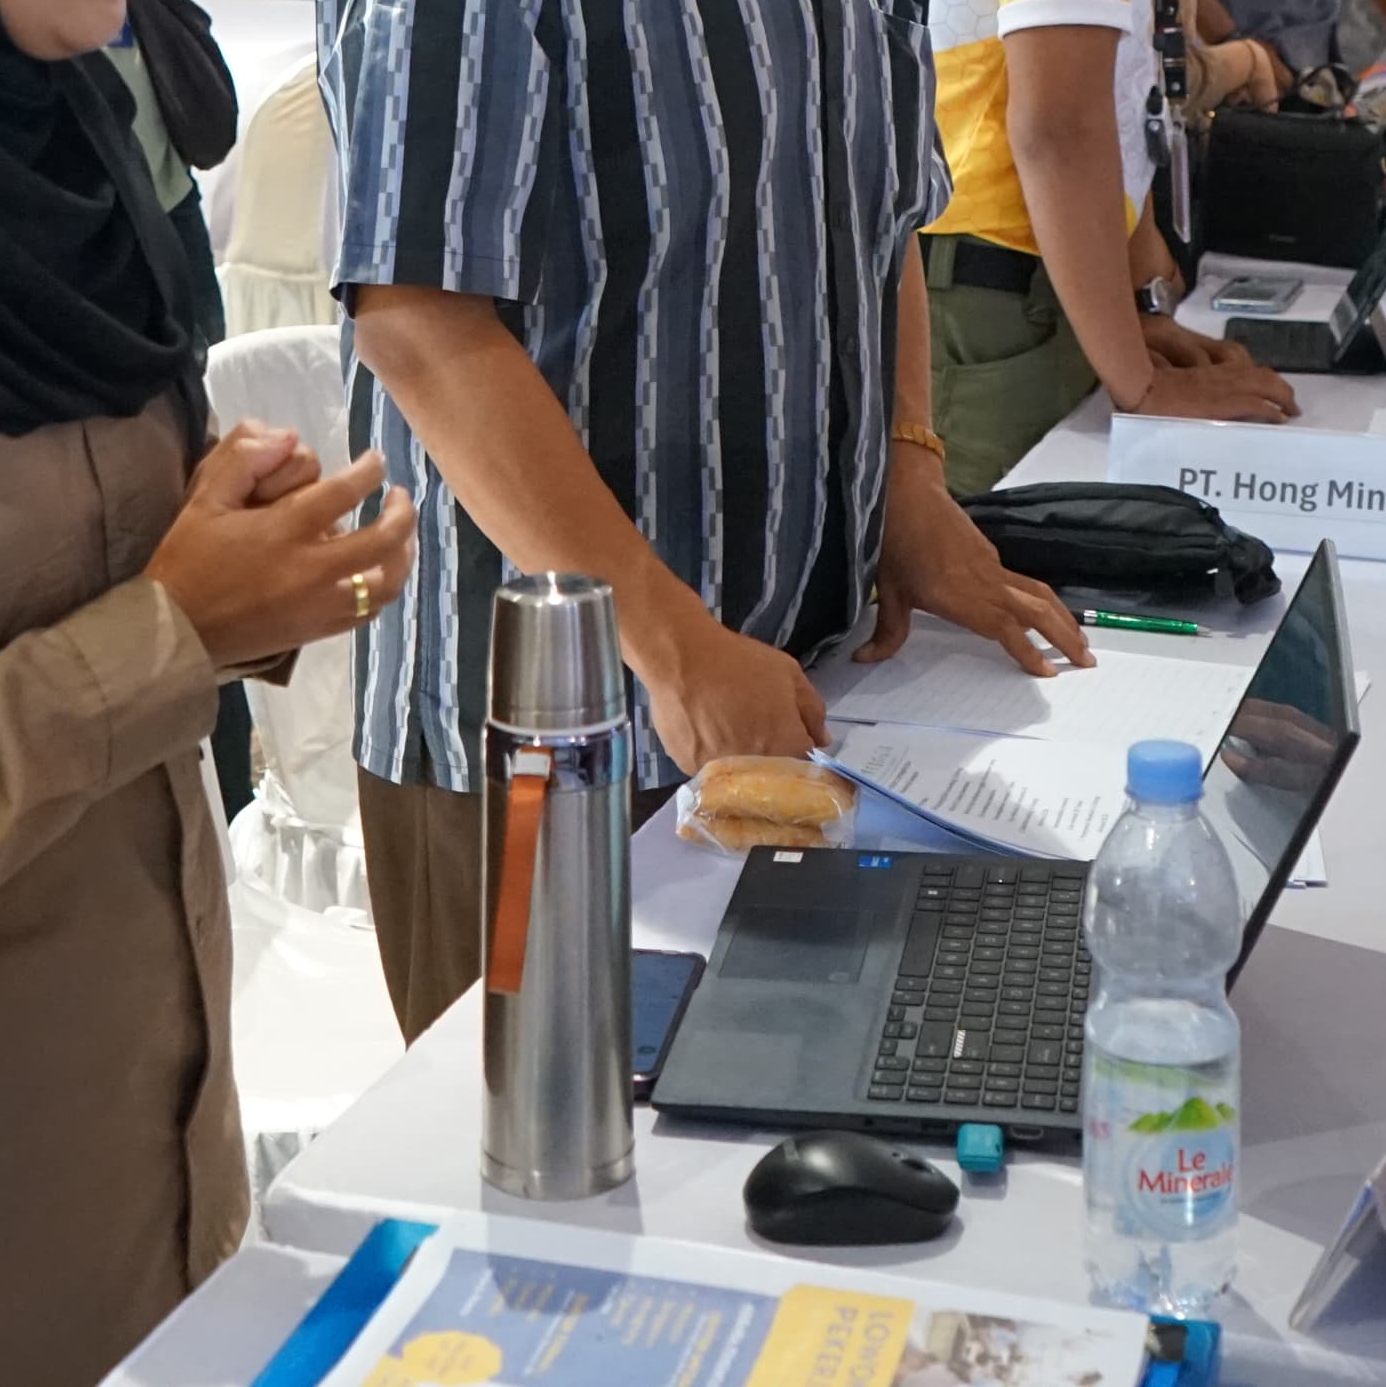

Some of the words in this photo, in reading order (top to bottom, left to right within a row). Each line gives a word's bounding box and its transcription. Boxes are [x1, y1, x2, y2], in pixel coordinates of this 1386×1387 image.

[1179, 468, 1221, 498] PT.
[1233, 472, 1319, 512] Hong
[1178, 1147, 1205, 1173] Le
